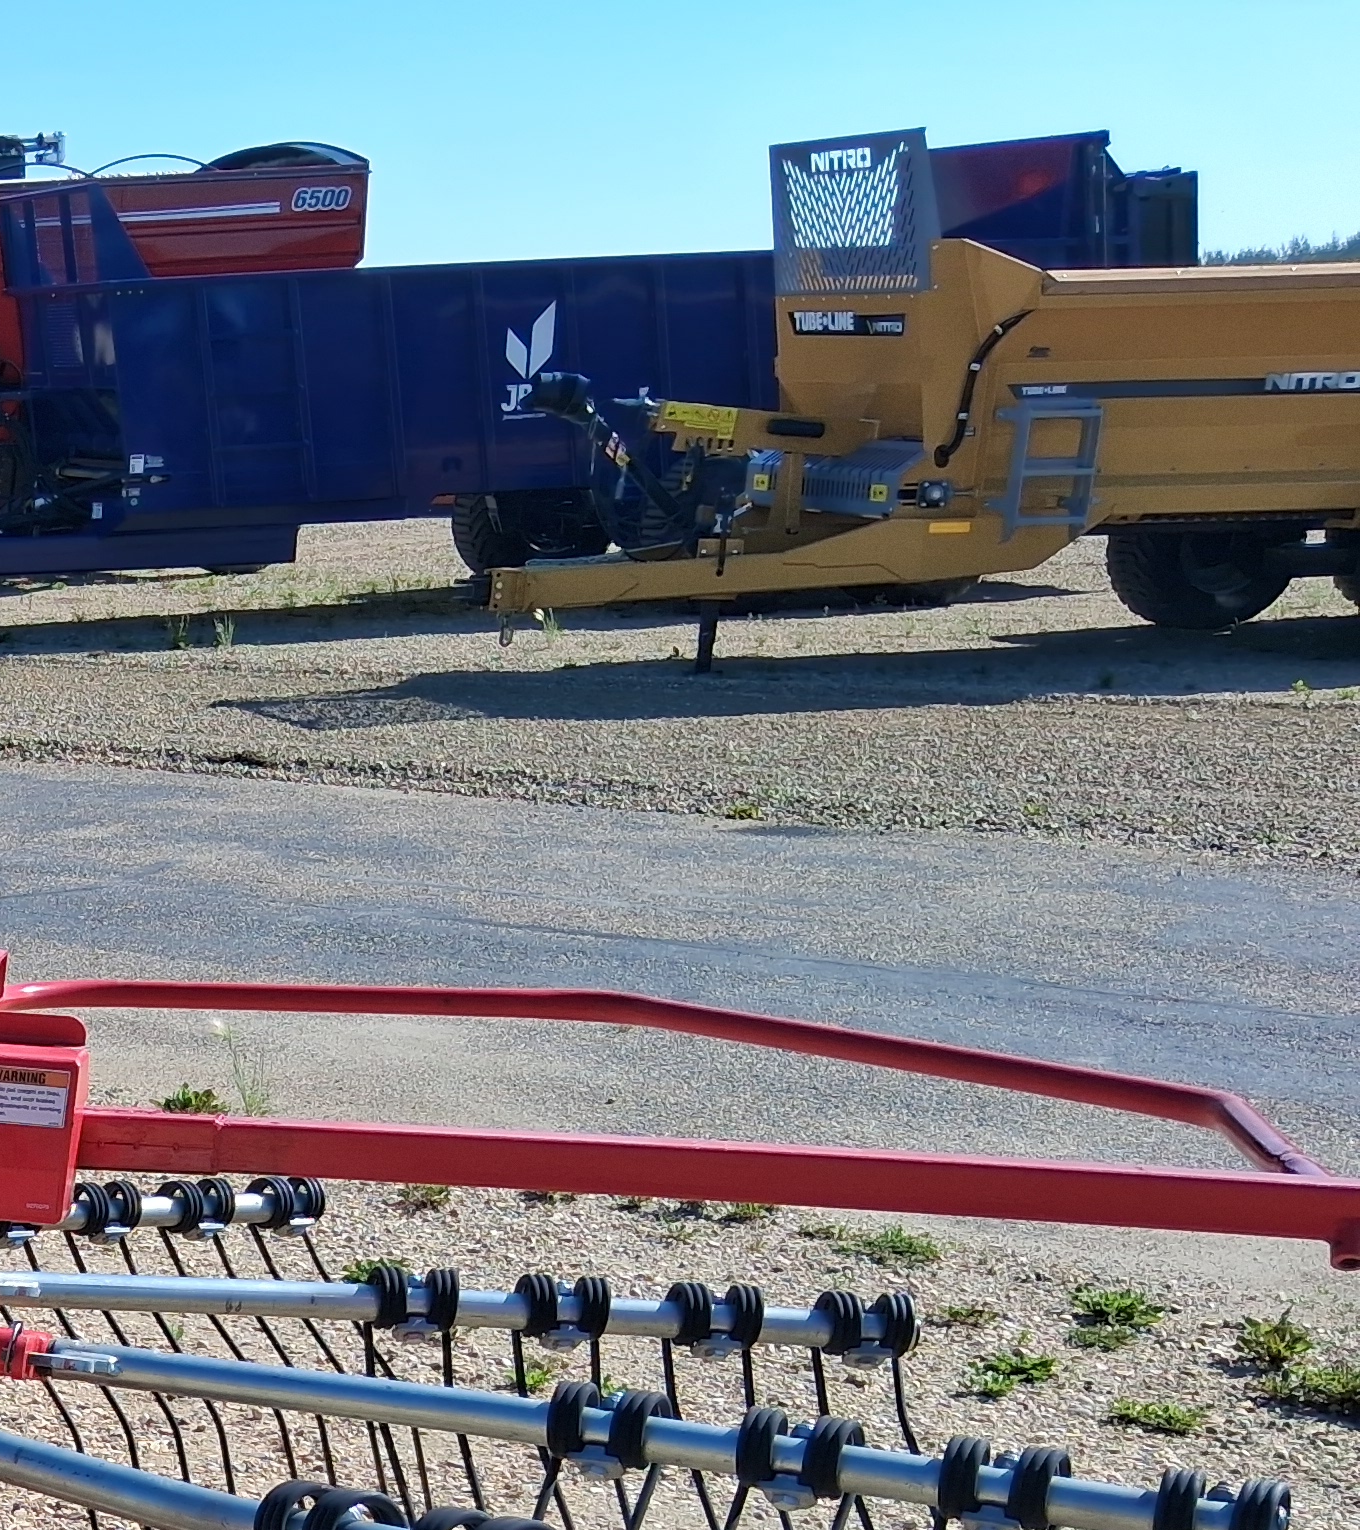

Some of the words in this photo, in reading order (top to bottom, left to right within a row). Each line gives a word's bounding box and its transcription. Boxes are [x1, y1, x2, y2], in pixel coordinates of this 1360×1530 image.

[810, 147, 872, 173] NITRO
[292, 187, 351, 210] 6500
[1263, 371, 1360, 391] NITRO
